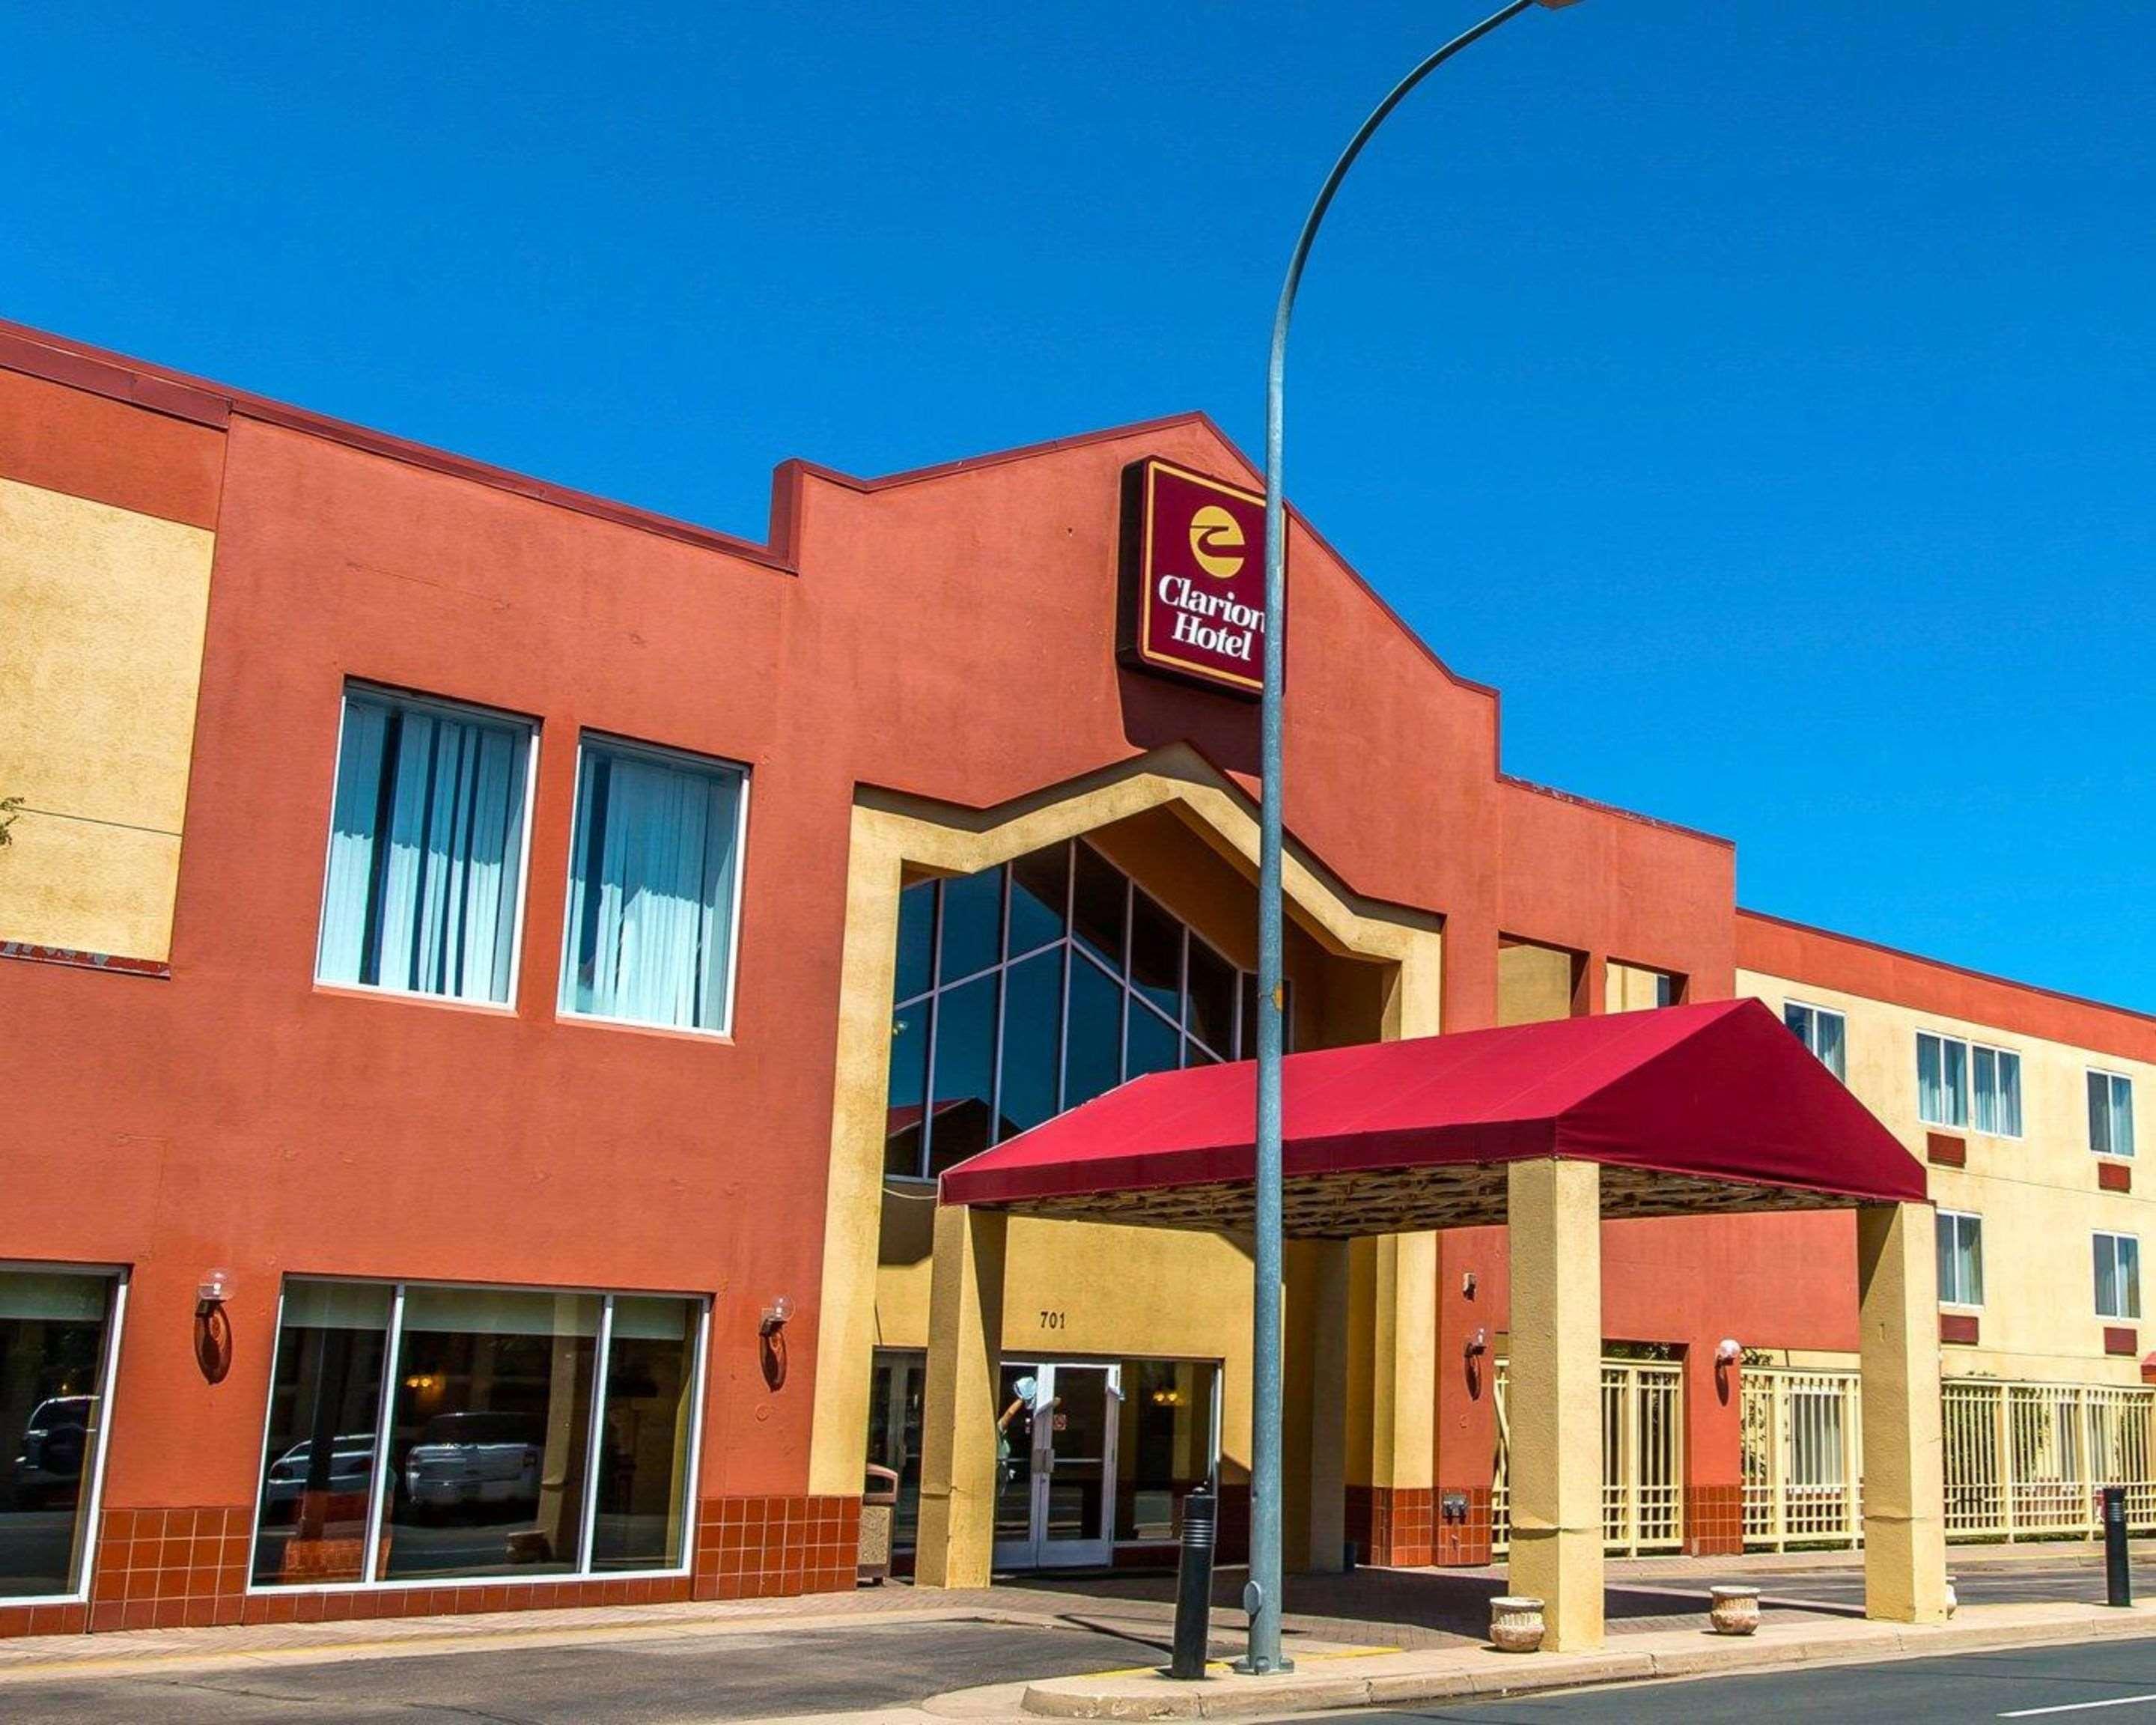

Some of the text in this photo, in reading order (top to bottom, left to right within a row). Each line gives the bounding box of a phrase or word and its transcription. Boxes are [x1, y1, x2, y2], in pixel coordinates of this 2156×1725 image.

[1159, 574, 1265, 633] Clarion
[1172, 611, 1251, 661] Hotel
[1041, 1311, 1065, 1329] 701
